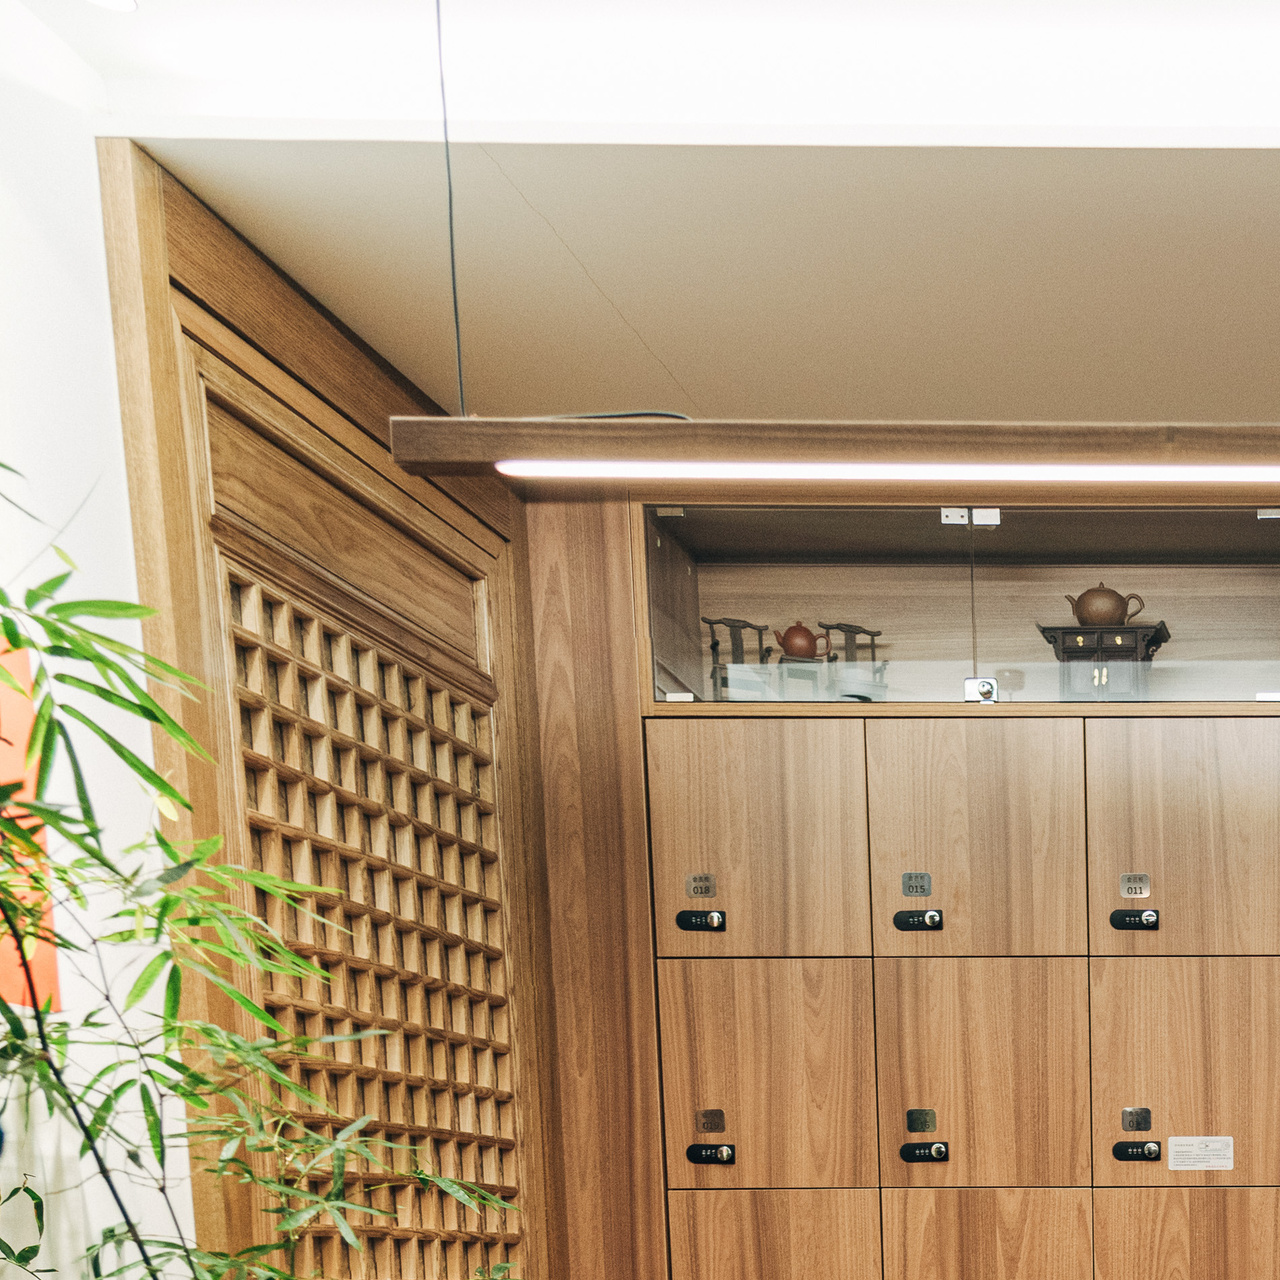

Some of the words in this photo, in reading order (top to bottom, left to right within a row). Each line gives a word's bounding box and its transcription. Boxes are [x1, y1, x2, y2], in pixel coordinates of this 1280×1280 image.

[692, 886, 710, 895] 018
[908, 884, 926, 893] 015
[1126, 886, 1144, 895] 011
